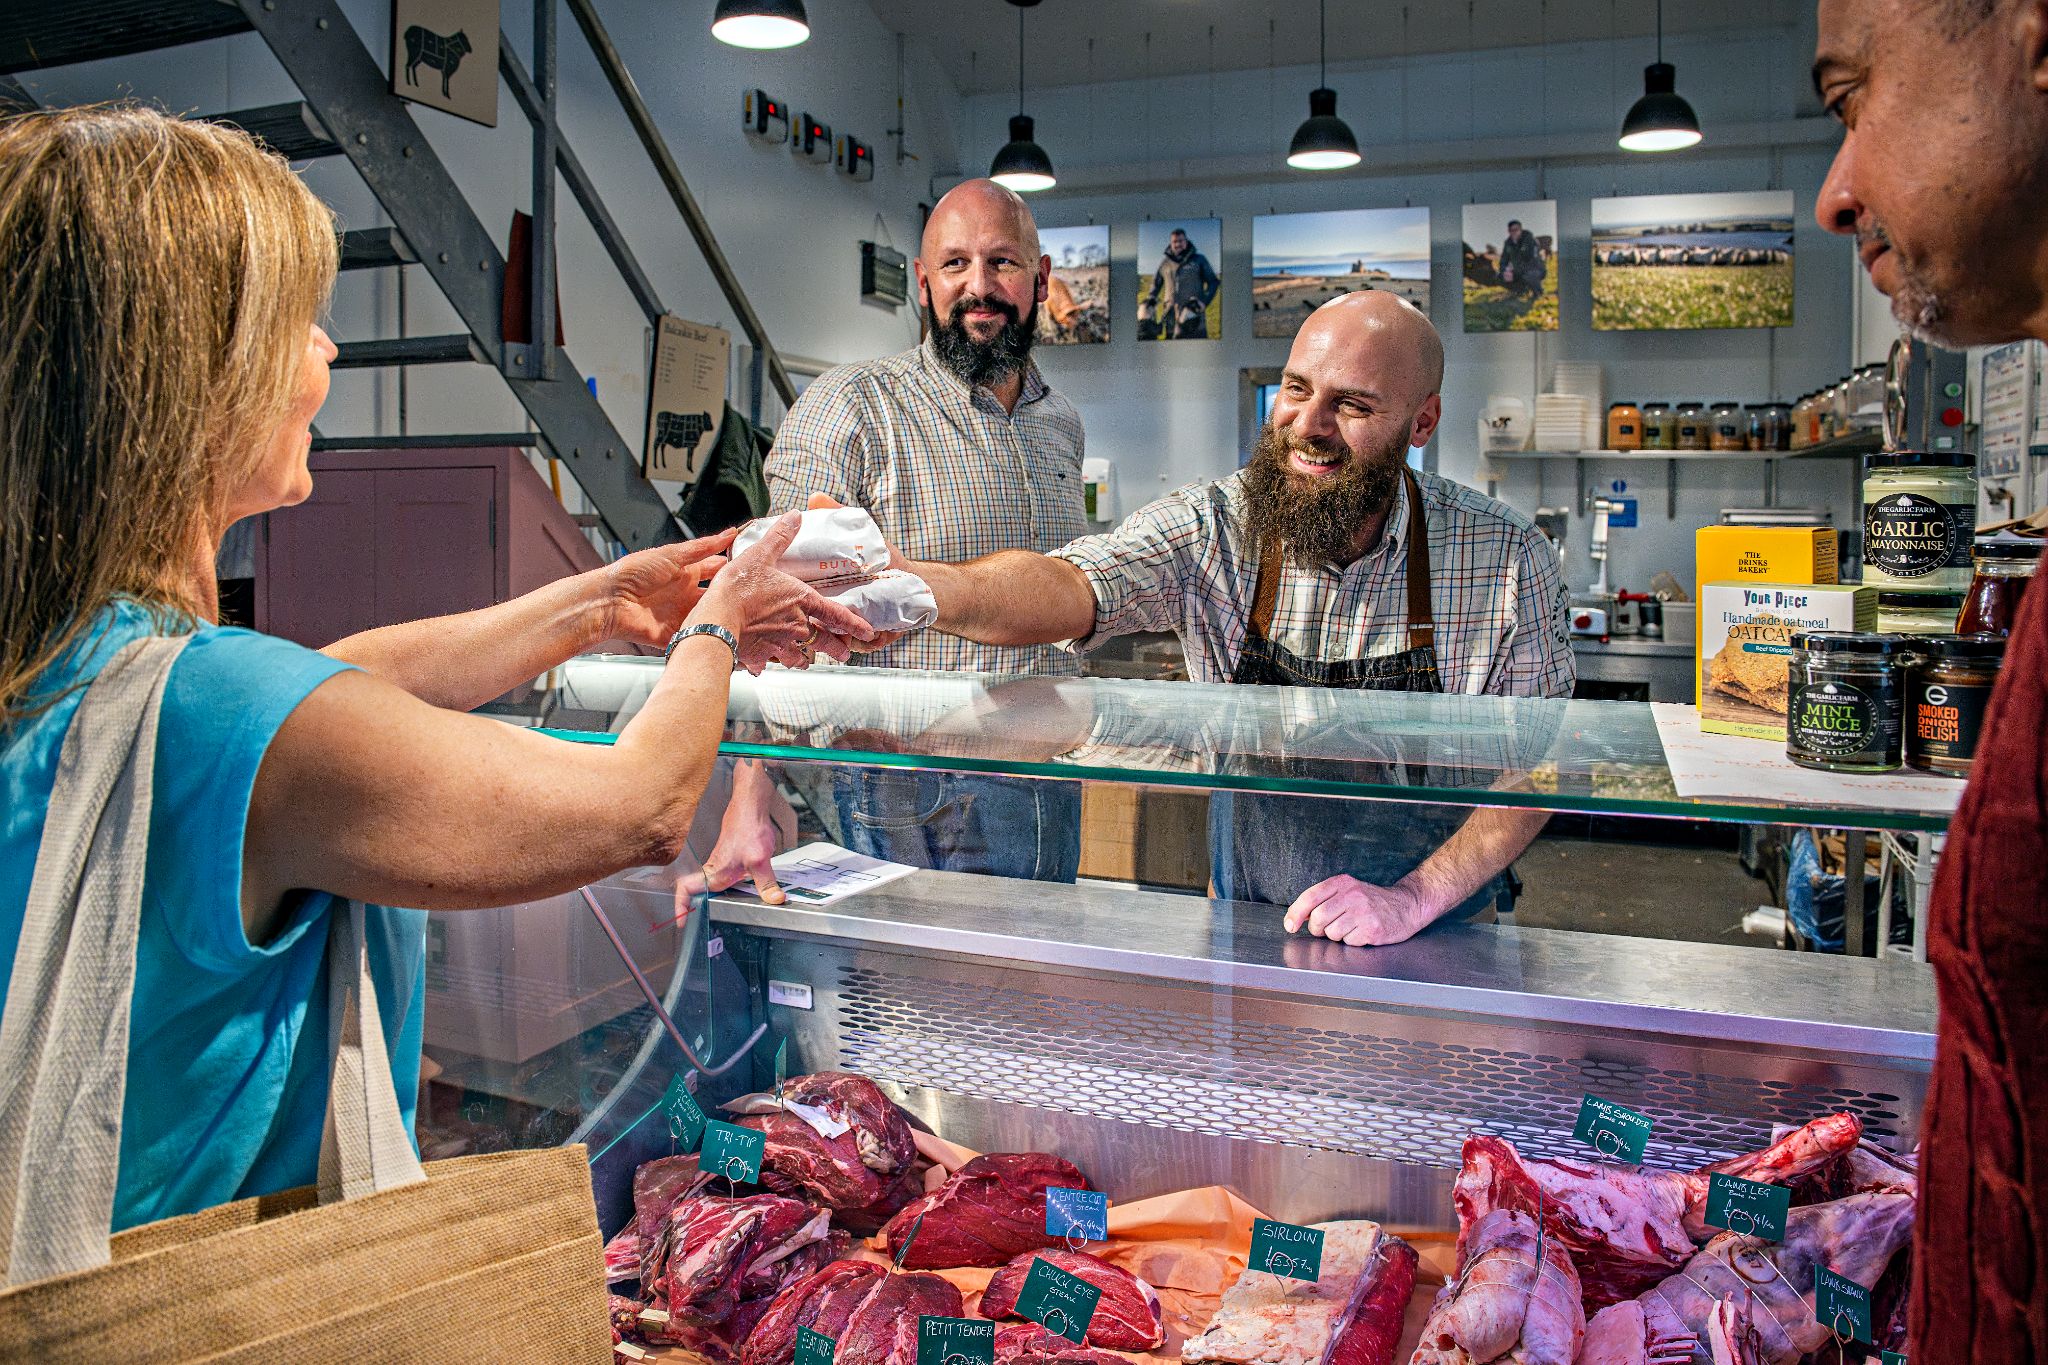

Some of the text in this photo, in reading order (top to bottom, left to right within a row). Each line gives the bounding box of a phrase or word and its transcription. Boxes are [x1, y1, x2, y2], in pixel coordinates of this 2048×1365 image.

[1871, 521, 1944, 538] GARLIC
[1871, 540, 1945, 551] MAYONNAISE
[1738, 566, 1768, 574] BAKERY
[1723, 612, 1829, 629] Handmade oatmeal
[1806, 703, 1855, 718] MINT
[1918, 704, 1959, 720] SMOKED
[1801, 714, 1861, 732] SAUCE
[1918, 716, 1959, 728] ONION
[1918, 725, 1959, 742] RELISH
[1587, 1099, 1612, 1114] LAMB
[716, 1129, 758, 1148] TRI-TIP
[1718, 1178, 1770, 1198] LAMB LEG
[1054, 1190, 1088, 1204] CENTRE
[1262, 1224, 1318, 1245] SIRLOIN
[1038, 1265, 1095, 1300] CHUCK EYE
[1820, 1272, 1840, 1292] LAMB
[1049, 1286, 1076, 1304] STEAK
[926, 1320, 993, 1338] PETIT TENDER
